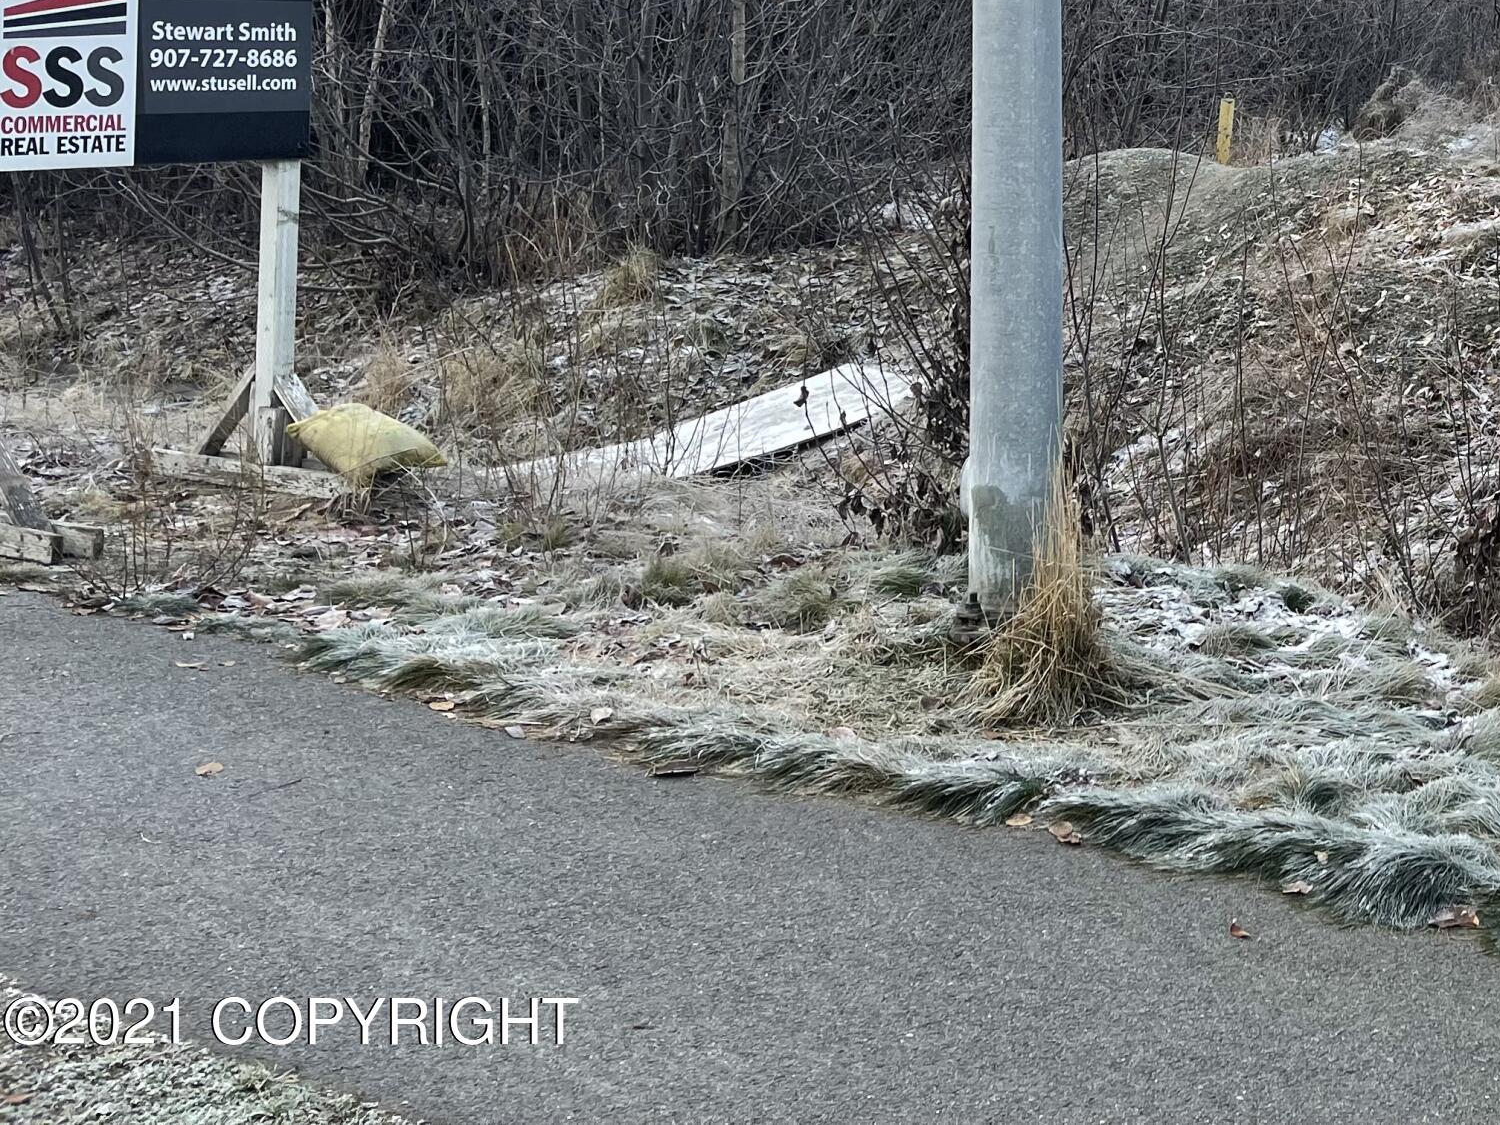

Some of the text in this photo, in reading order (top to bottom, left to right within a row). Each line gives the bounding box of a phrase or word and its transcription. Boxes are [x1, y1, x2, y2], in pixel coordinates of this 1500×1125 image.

[151, 21, 297, 43] Stewart Smith
[149, 48, 298, 69] 907-727-8686
[0, 45, 125, 109] SSS
[150, 74, 297, 93] www.stusell.com
[1, 114, 127, 134] COMMERCIAL
[1, 134, 126, 157] REAL ESTATE
